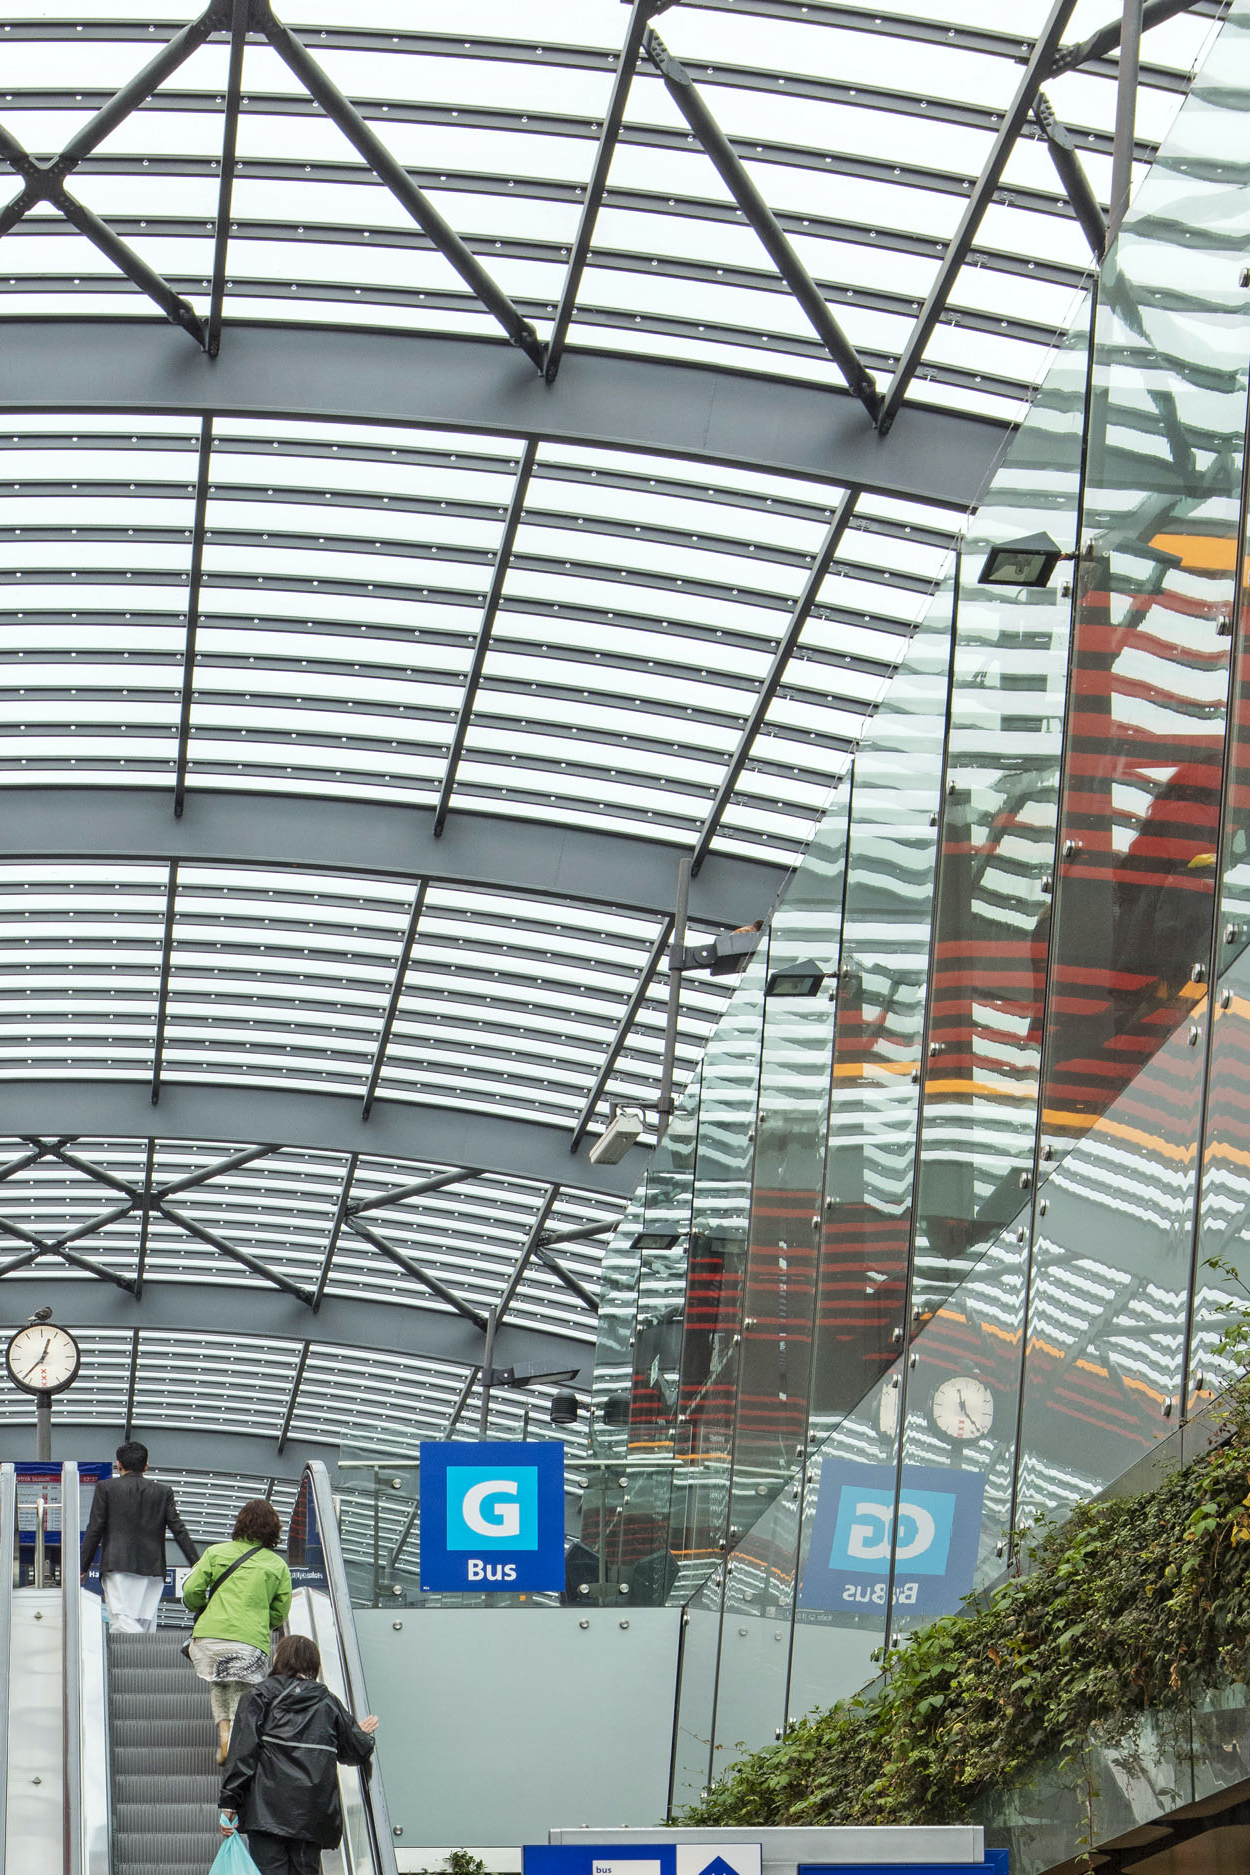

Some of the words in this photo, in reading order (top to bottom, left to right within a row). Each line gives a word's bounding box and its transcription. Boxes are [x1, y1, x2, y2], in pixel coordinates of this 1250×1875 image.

[462, 1480, 520, 1537] G
[467, 1559, 517, 1581] Bus
[596, 1866, 612, 1874] bus
